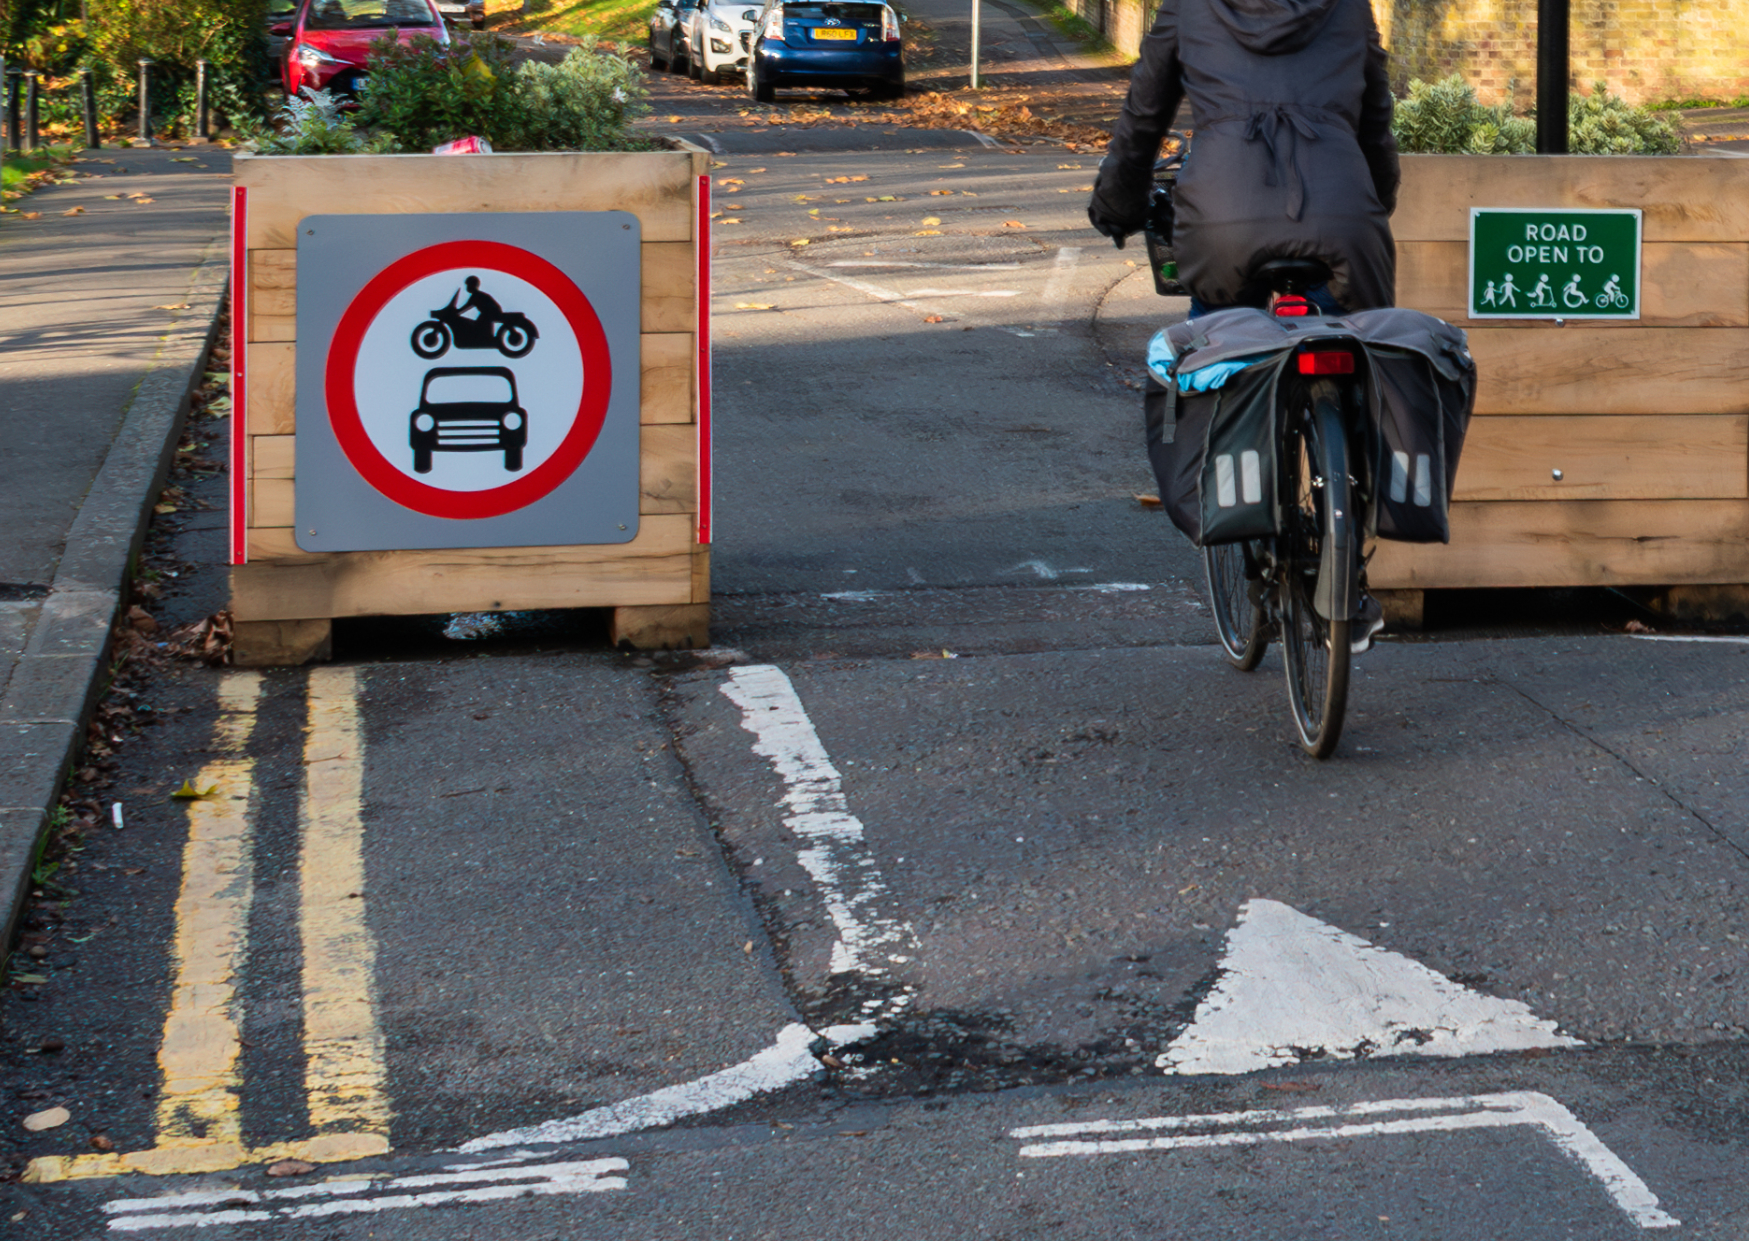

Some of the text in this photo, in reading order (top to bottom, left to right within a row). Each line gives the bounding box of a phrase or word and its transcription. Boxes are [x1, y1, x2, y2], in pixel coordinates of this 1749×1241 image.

[1526, 223, 1587, 242] ROAD
[1507, 244, 1604, 264] OPEN TO
